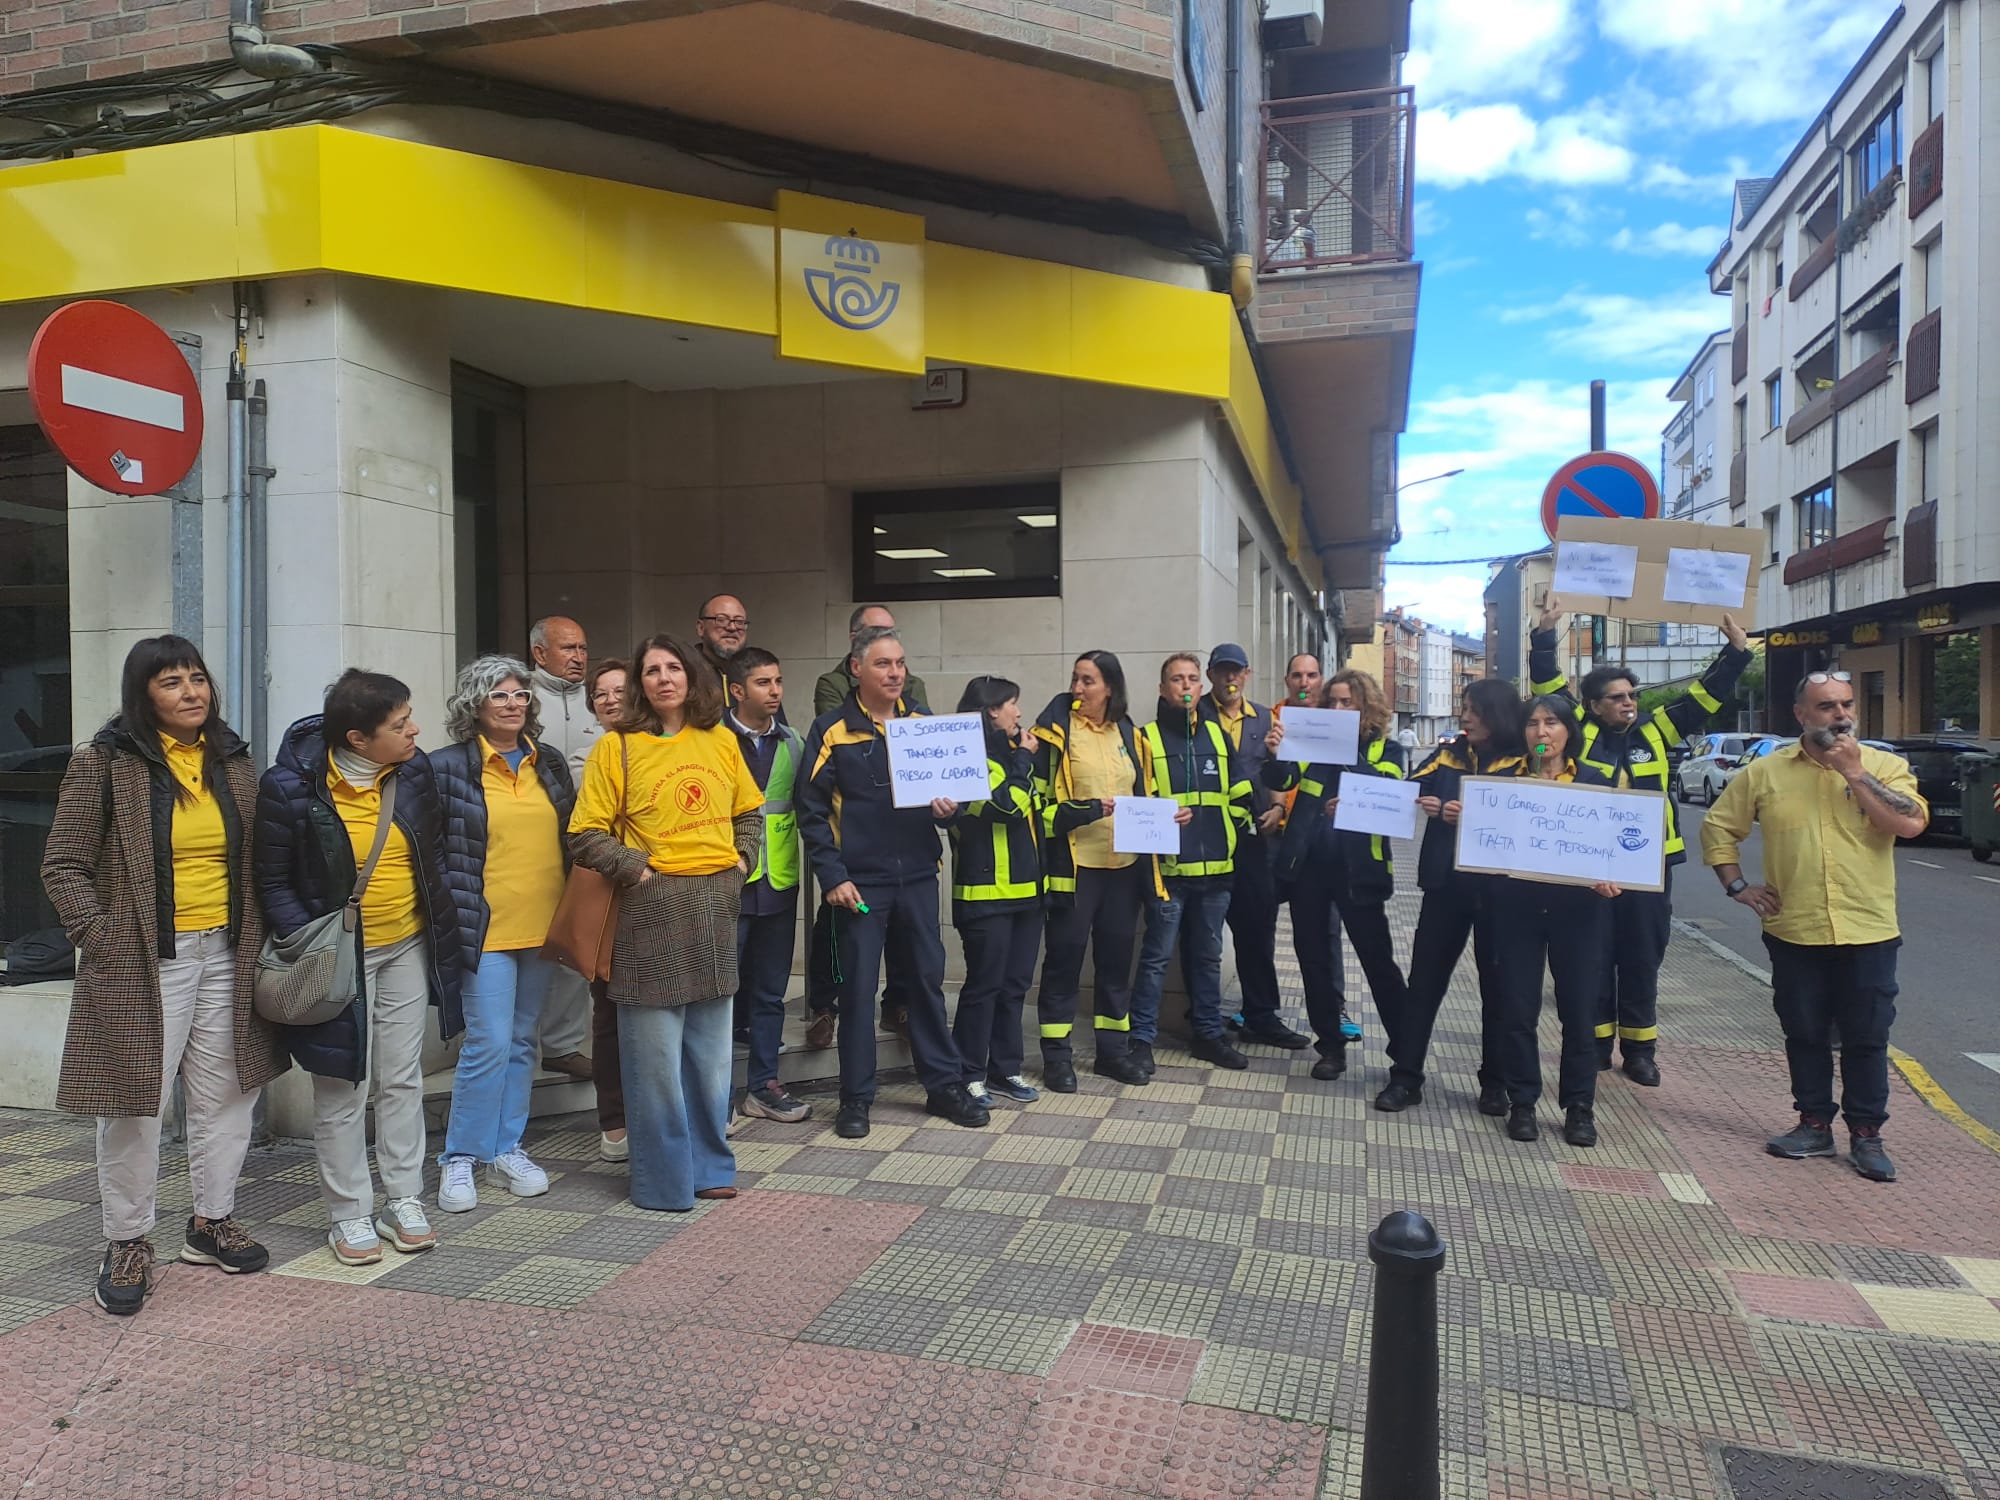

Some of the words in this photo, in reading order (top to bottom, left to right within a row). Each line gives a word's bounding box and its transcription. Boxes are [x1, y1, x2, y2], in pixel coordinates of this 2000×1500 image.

[1769, 631, 1829, 647] GADIS
[889, 723, 908, 738] LA
[953, 745, 967, 756] ES
[896, 769, 933, 781] RIESGO
[941, 766, 984, 780] LABORAL
[1473, 787, 1498, 808] TU
[1507, 793, 1547, 813] CORREO
[1557, 801, 1600, 821] LLEGA
[1605, 806, 1645, 823] TARDE
[1473, 827, 1516, 852] FALTA
[1529, 836, 1549, 850] DE
[1555, 840, 1617, 861] PERSONAL
